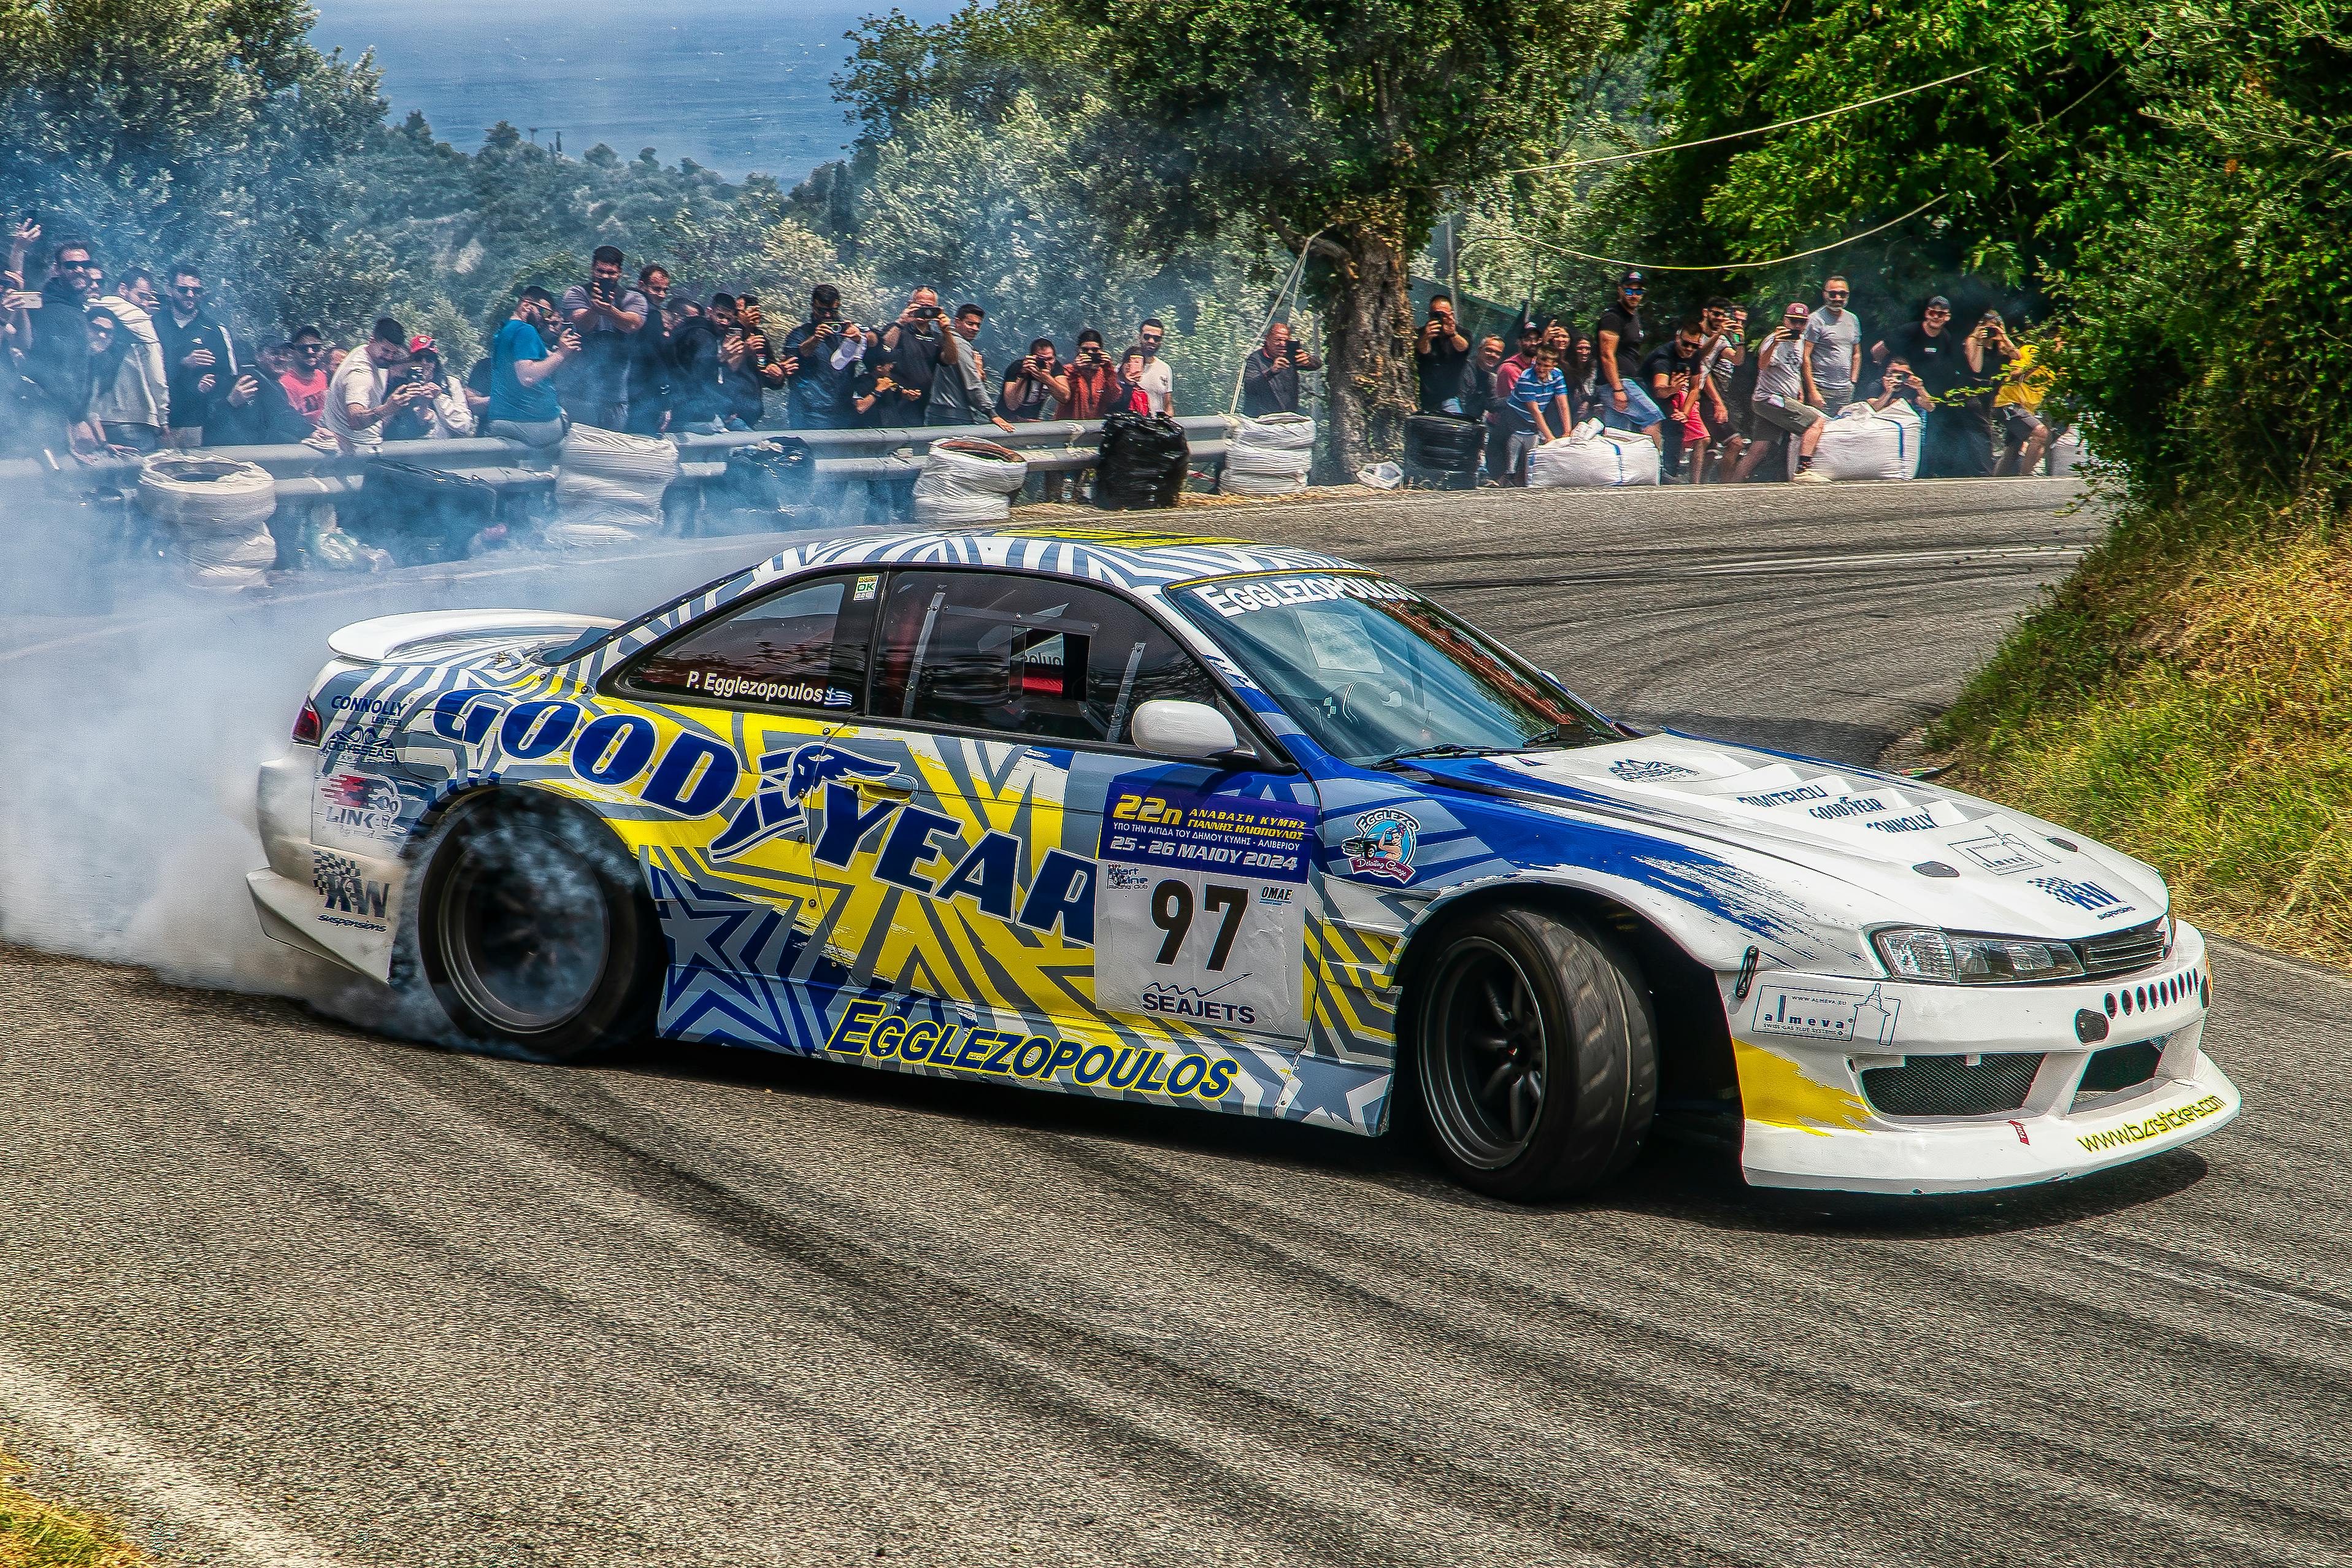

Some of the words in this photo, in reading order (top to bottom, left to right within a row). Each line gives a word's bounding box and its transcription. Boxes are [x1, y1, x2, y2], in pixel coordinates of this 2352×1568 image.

[857, 583, 876, 591] OK
[1191, 577, 1422, 618] EGGLEZOPOULOS
[686, 671, 699, 689] P.
[704, 672, 824, 701] Egglezopoulos
[331, 694, 407, 717] CONNOLLY
[432, 688, 742, 820] GOOD
[812, 783, 1099, 945] YEAR
[1358, 810, 1418, 832] EGGLEZO
[1110, 836, 1137, 851] 25
[1148, 840, 1176, 856] 26
[1242, 851, 1298, 870] 2024
[1150, 878, 1250, 973] 97
[1142, 993, 1256, 1026] SEAJETS
[1764, 994, 1845, 1029] almeva
[824, 998, 1240, 1100] EGGLEZOPOULOS
